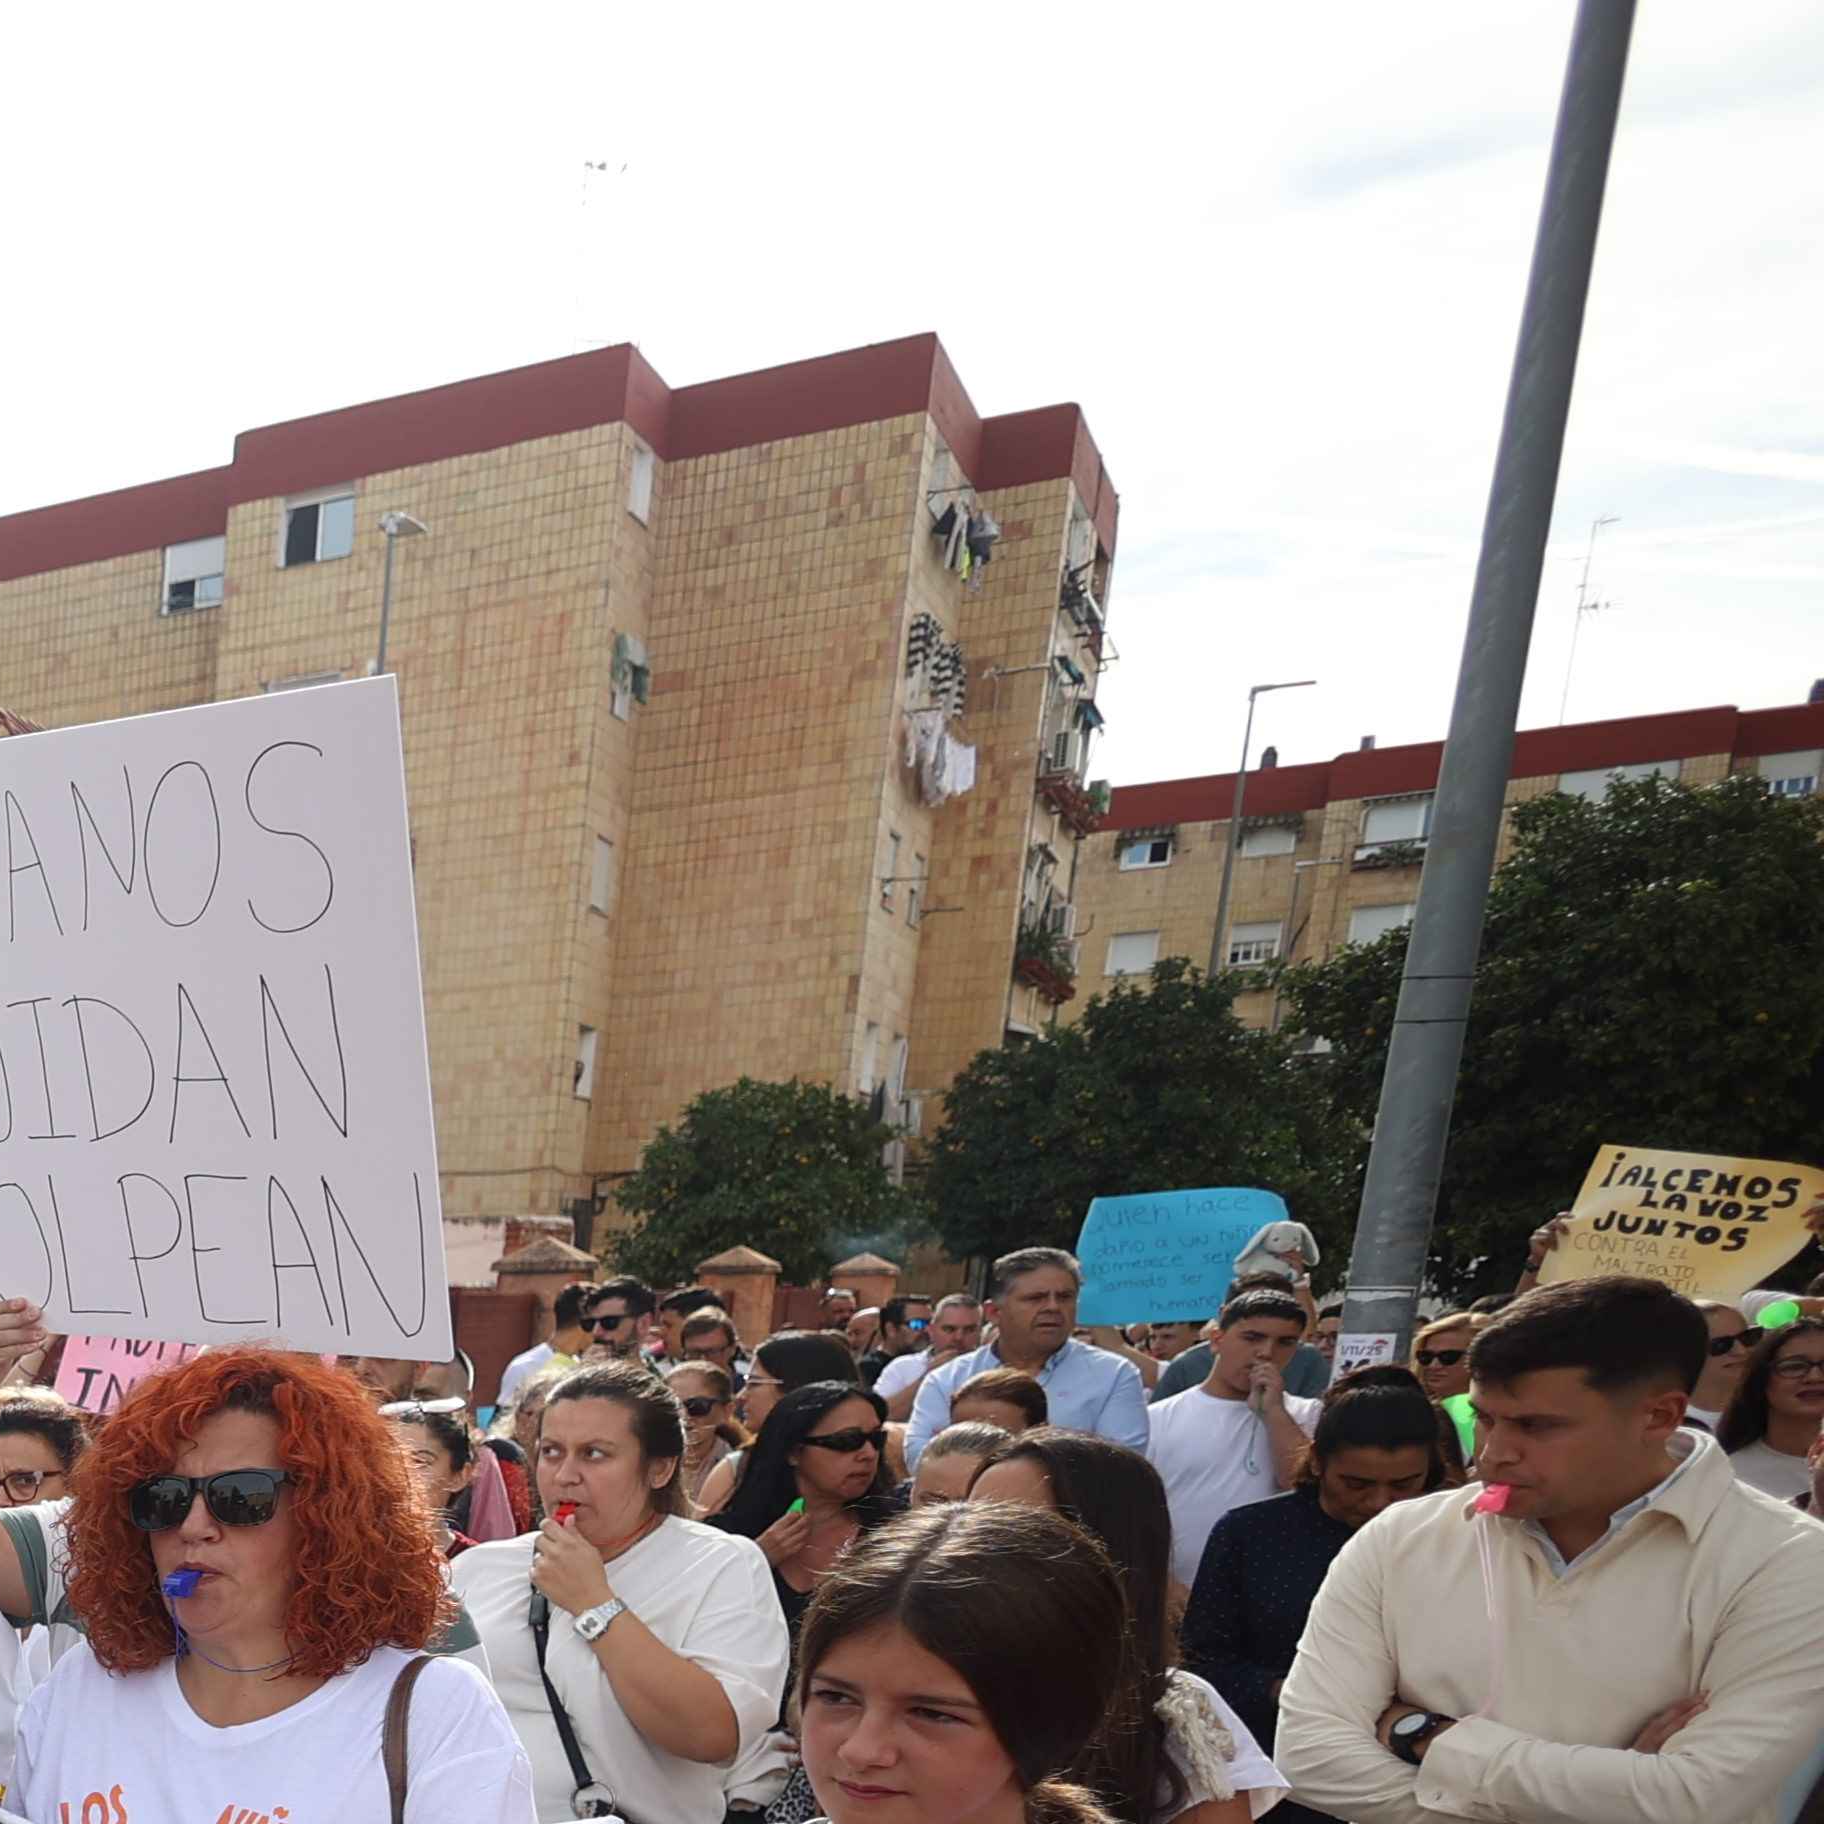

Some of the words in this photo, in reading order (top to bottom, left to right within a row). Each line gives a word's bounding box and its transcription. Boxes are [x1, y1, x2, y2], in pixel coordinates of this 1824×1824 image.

[1638, 1188, 1688, 1213] LA
[1697, 1198, 1774, 1223] VOZ
[1573, 1231, 1659, 1257] CONTRA
[1667, 1245, 1689, 1260] EL
[1592, 1209, 1749, 1252] JUNTOS
